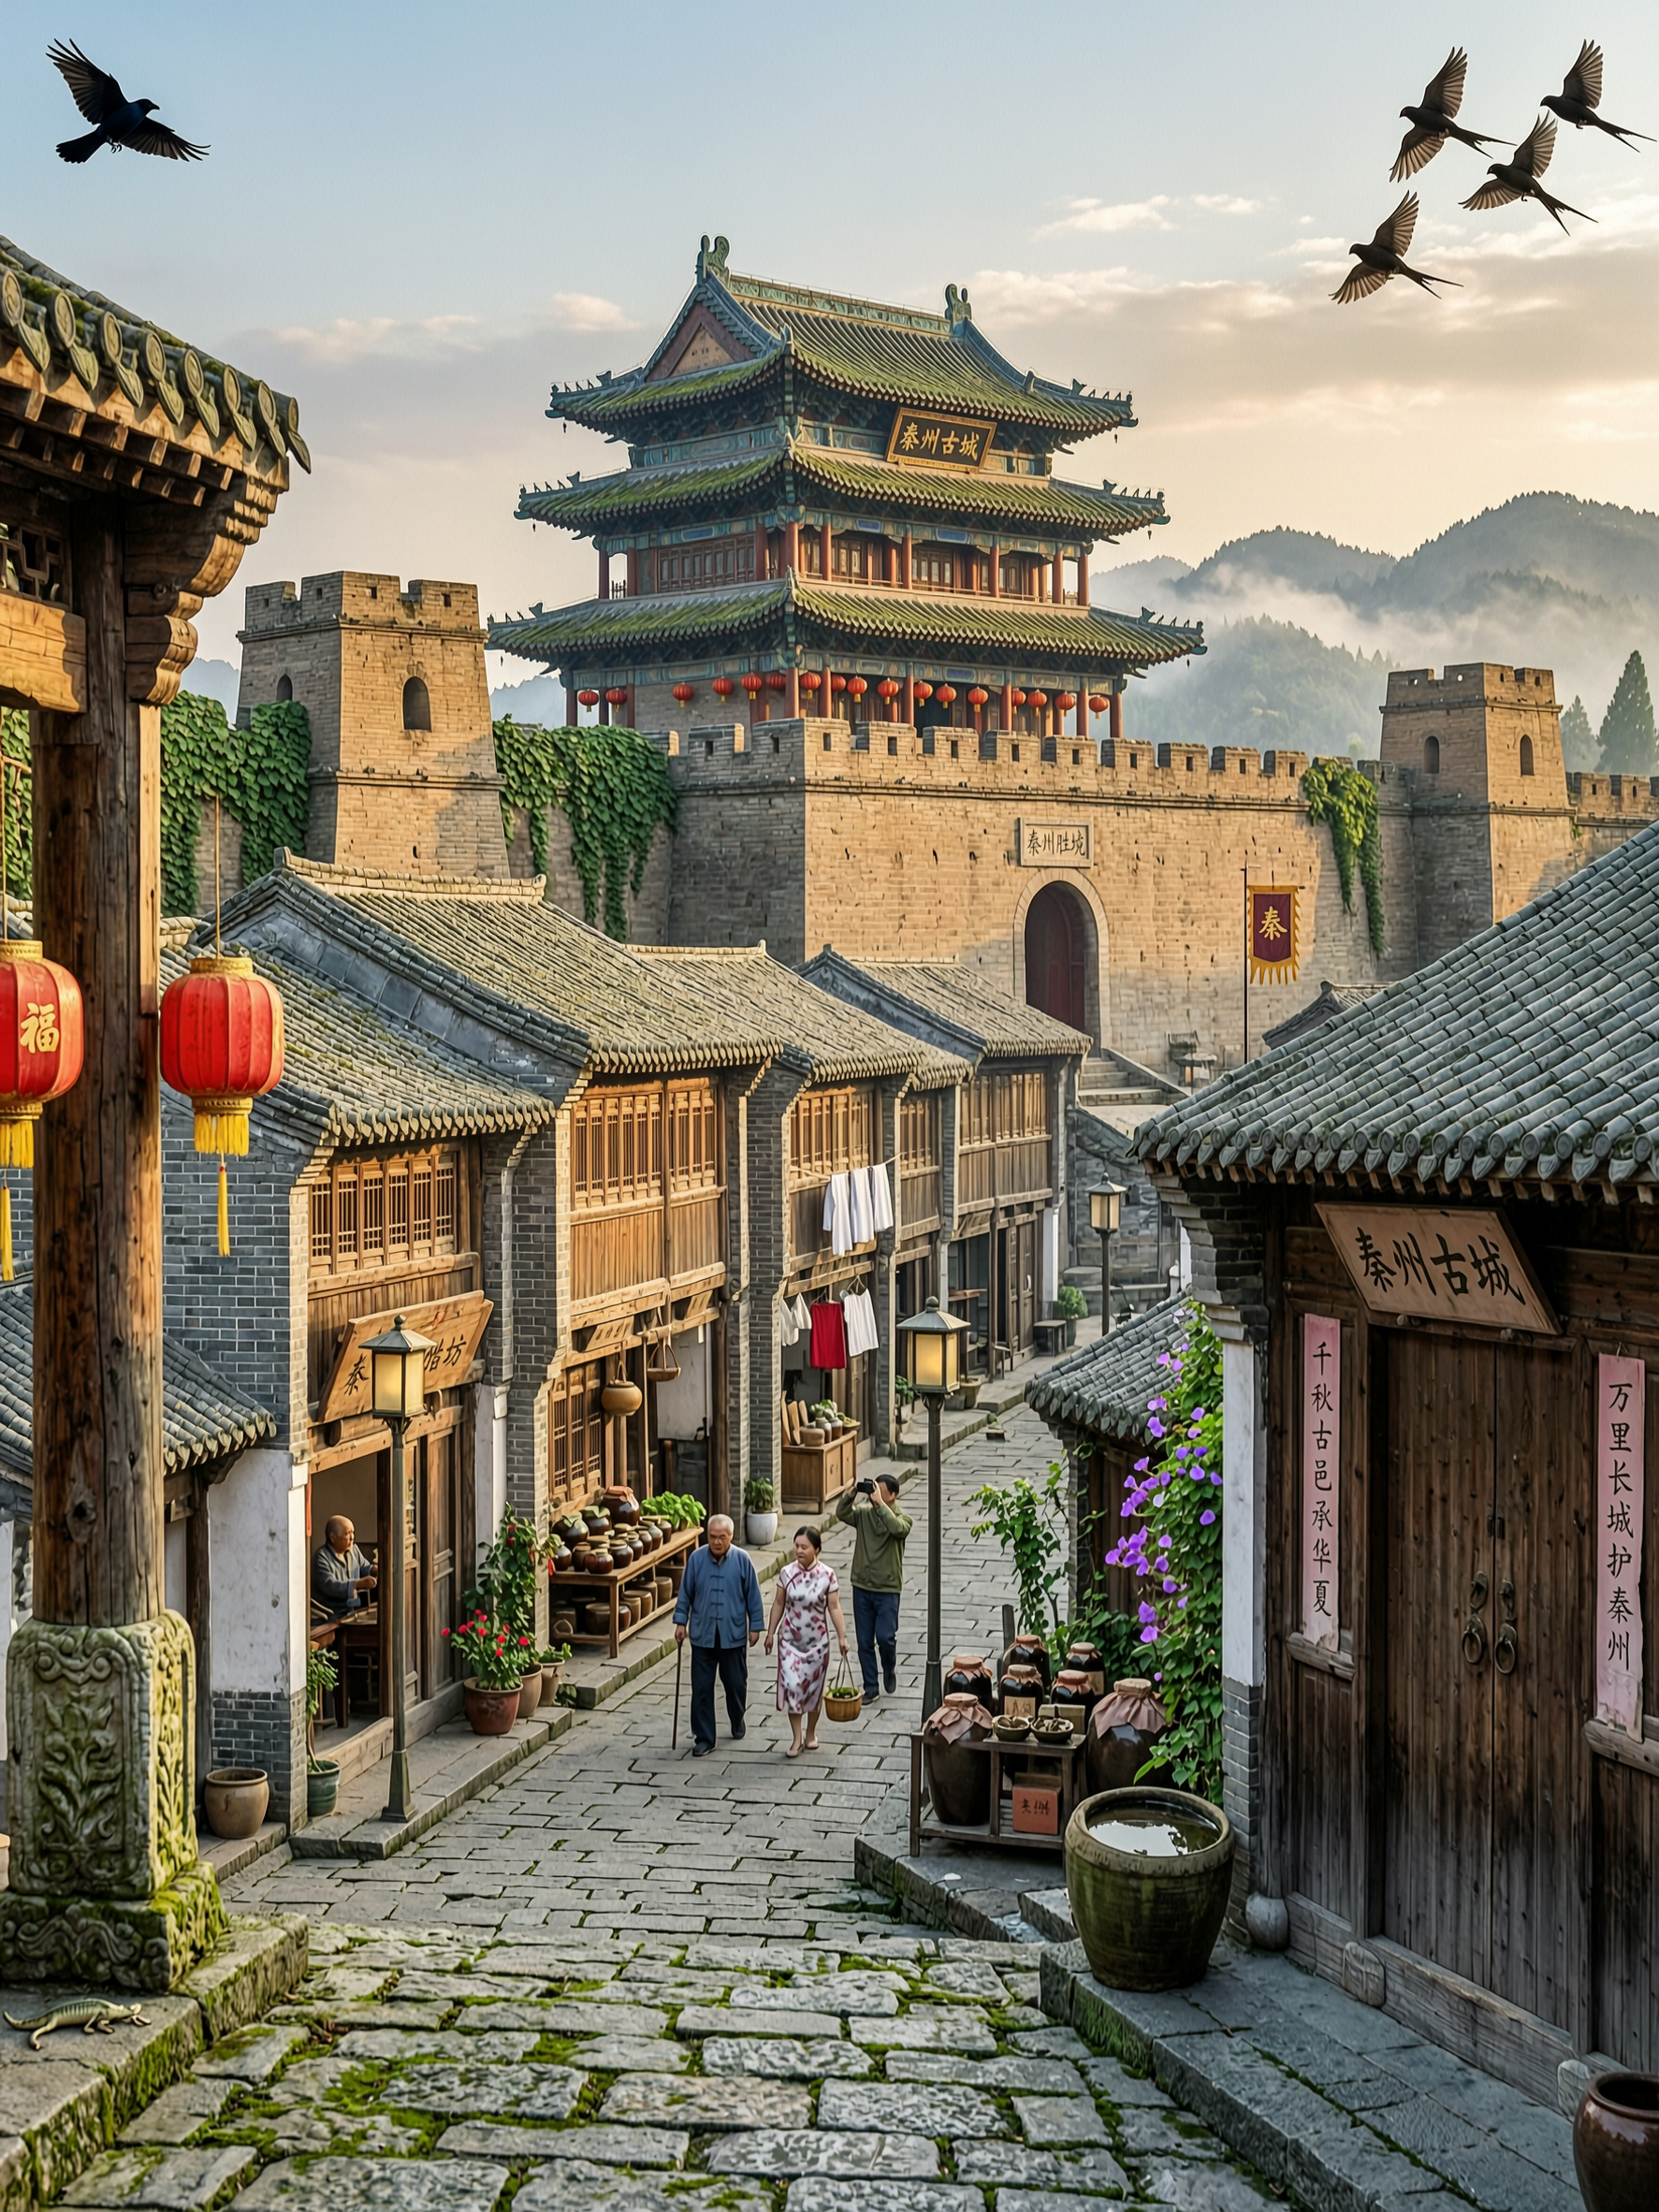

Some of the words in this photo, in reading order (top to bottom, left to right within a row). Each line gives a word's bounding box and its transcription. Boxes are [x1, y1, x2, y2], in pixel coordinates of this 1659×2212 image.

[900, 422, 980, 461] 秦州古城
[1259, 906, 1288, 941] 秦
[20, 1002, 60, 1054] 福
[1355, 1227, 1526, 1305] 秦州古城
[1311, 1341, 1333, 1617] 千秋古邑承华夏
[1607, 1383, 1634, 1671] 万里长城护秦州
